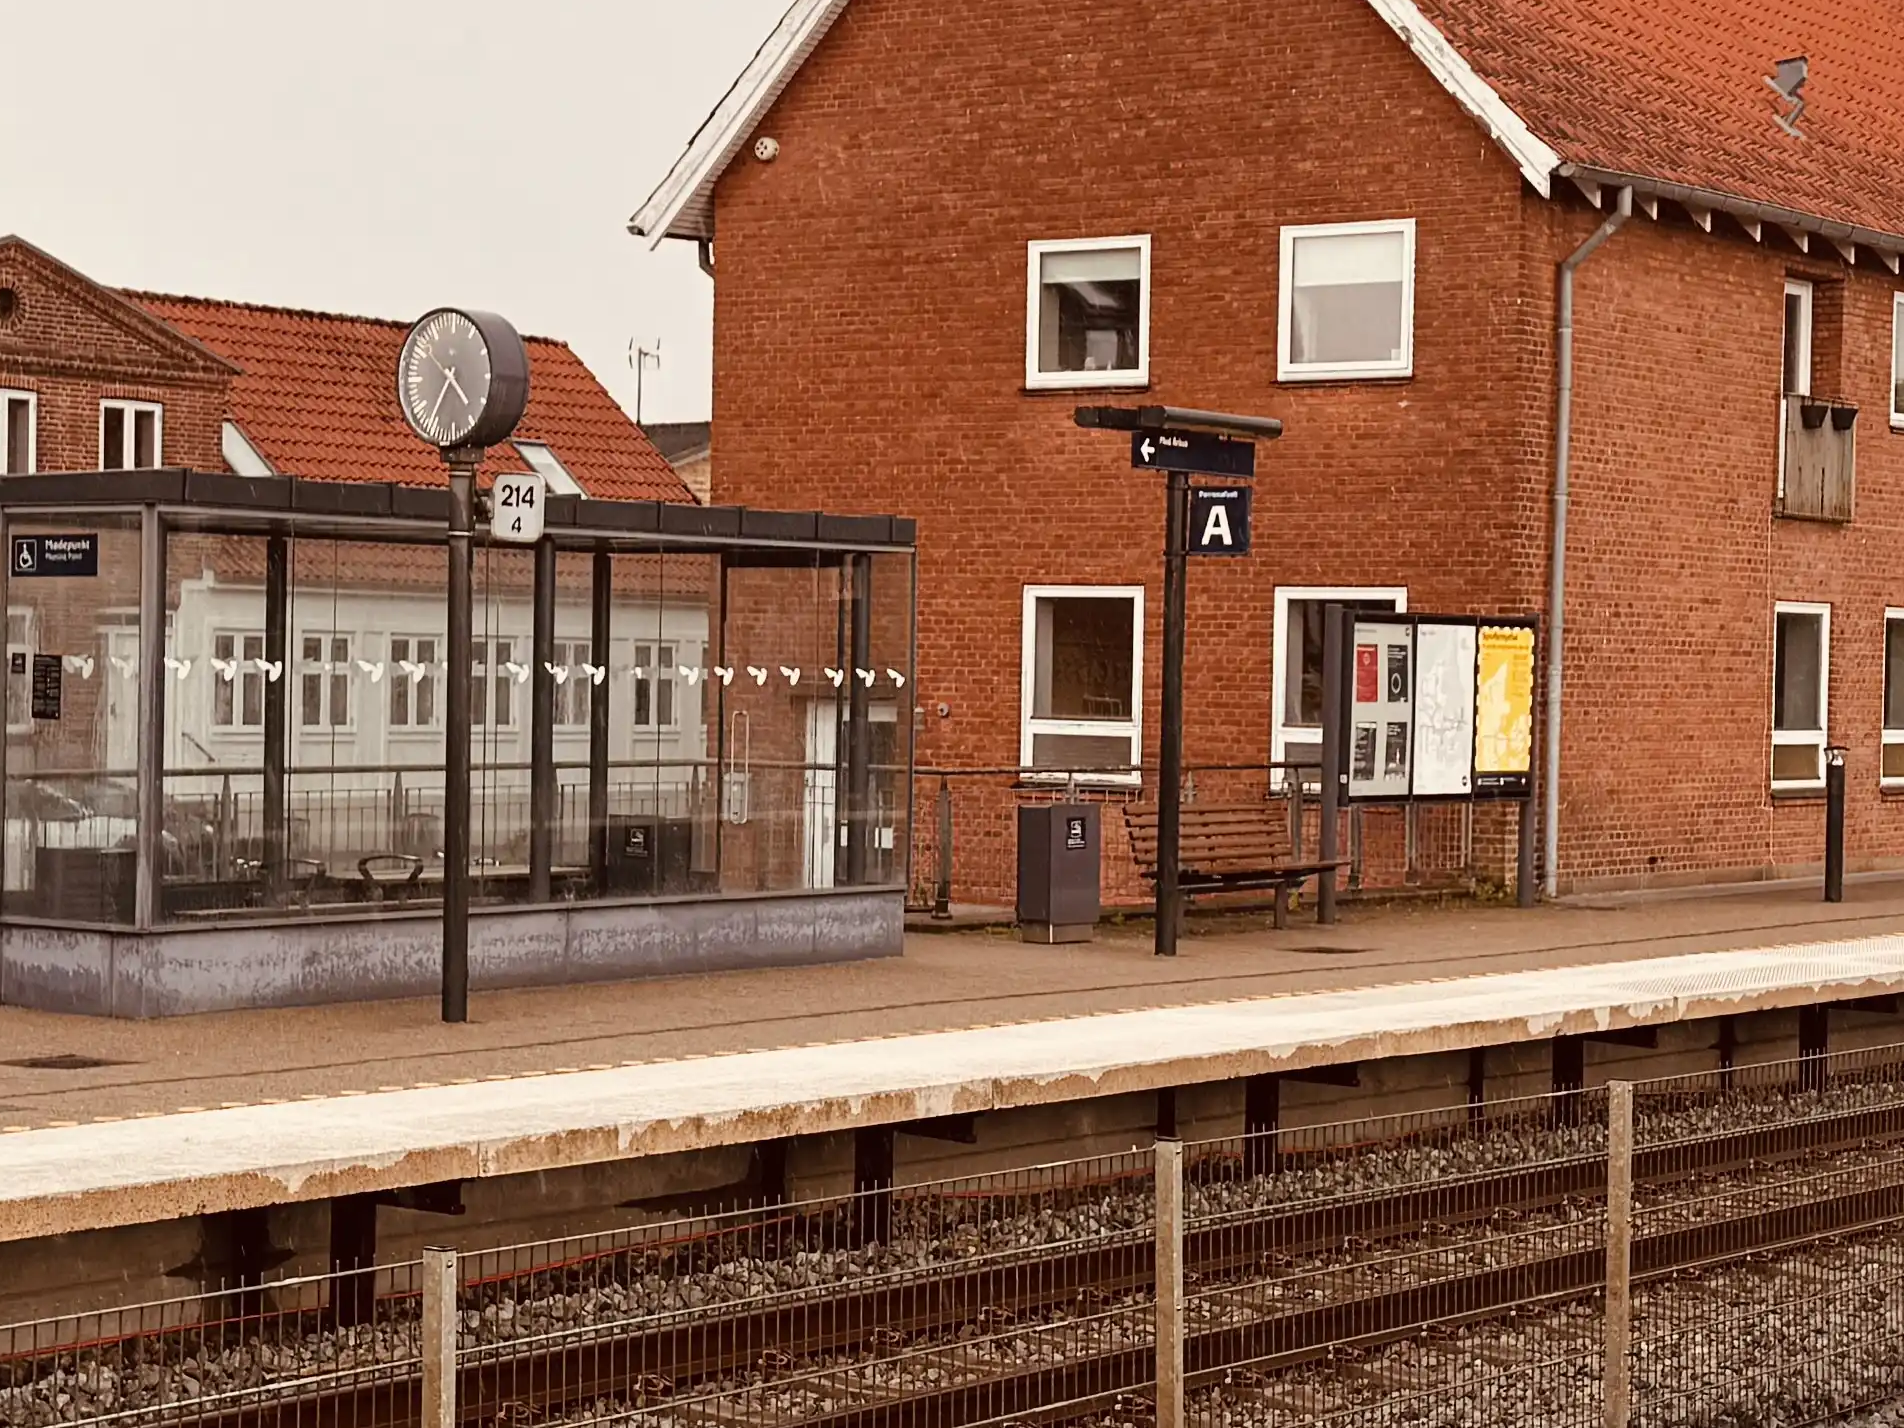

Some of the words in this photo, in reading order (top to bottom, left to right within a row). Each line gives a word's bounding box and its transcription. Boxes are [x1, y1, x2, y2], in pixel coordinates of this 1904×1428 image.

[501, 484, 535, 509] 214
[511, 516, 522, 533] 4
[1201, 505, 1233, 546] A
